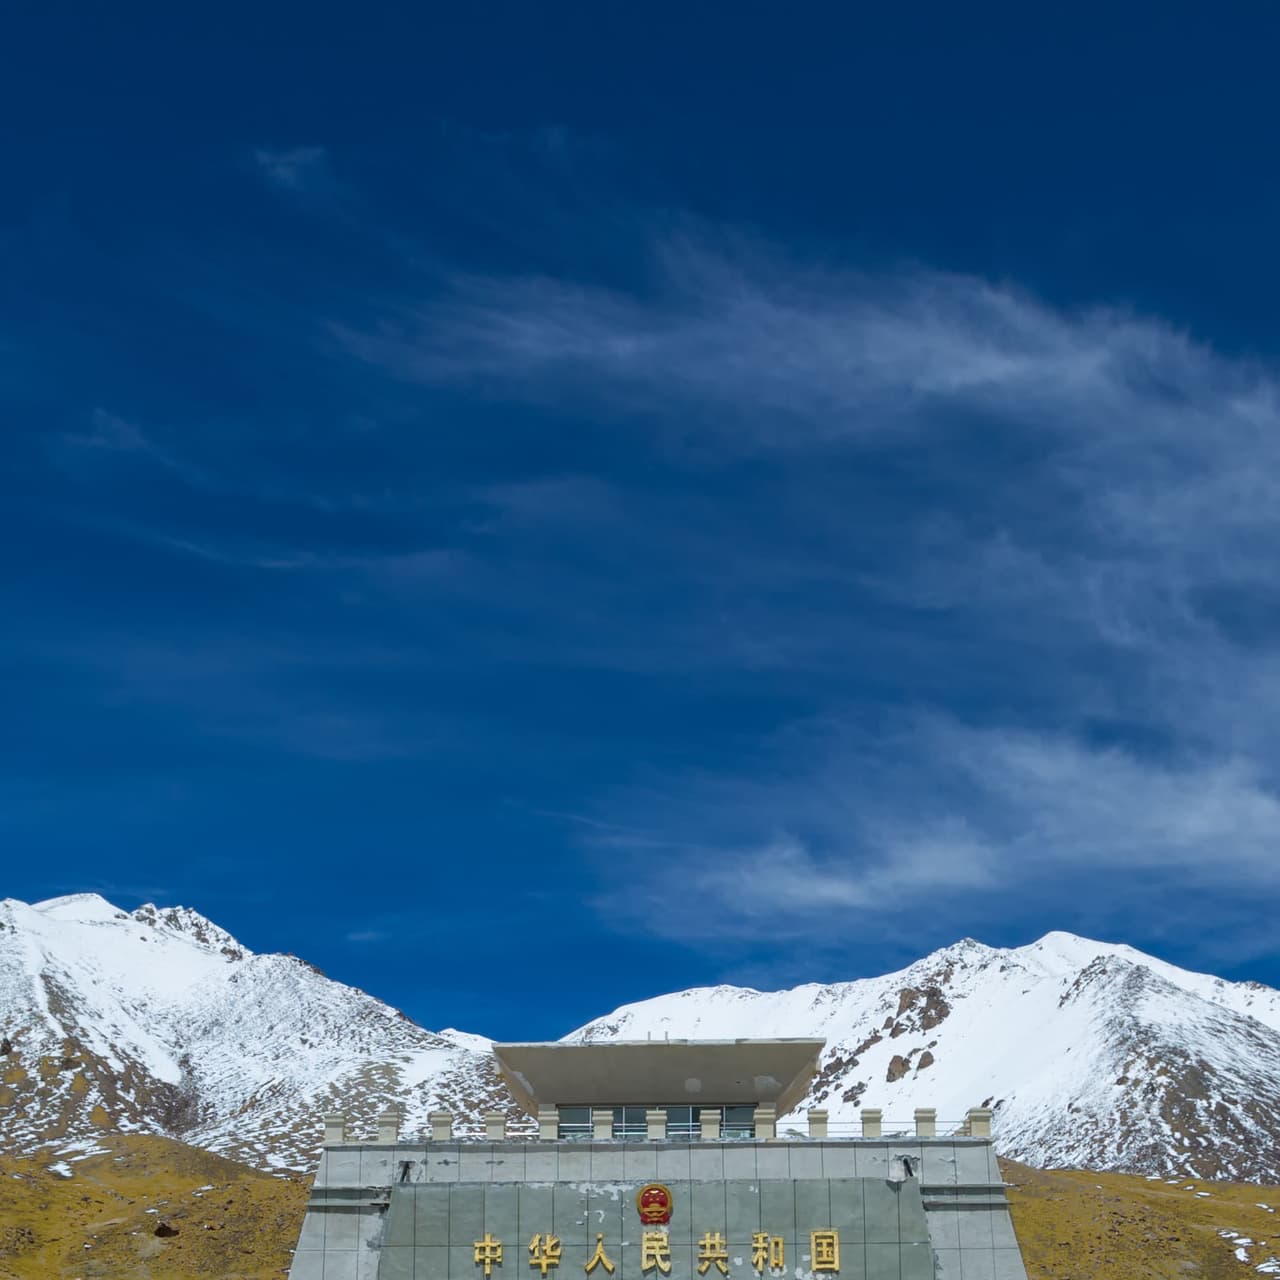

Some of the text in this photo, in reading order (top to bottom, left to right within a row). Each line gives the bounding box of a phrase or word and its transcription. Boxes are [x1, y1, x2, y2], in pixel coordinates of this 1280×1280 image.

[473, 1230, 840, 1276] 中华人民共和国
